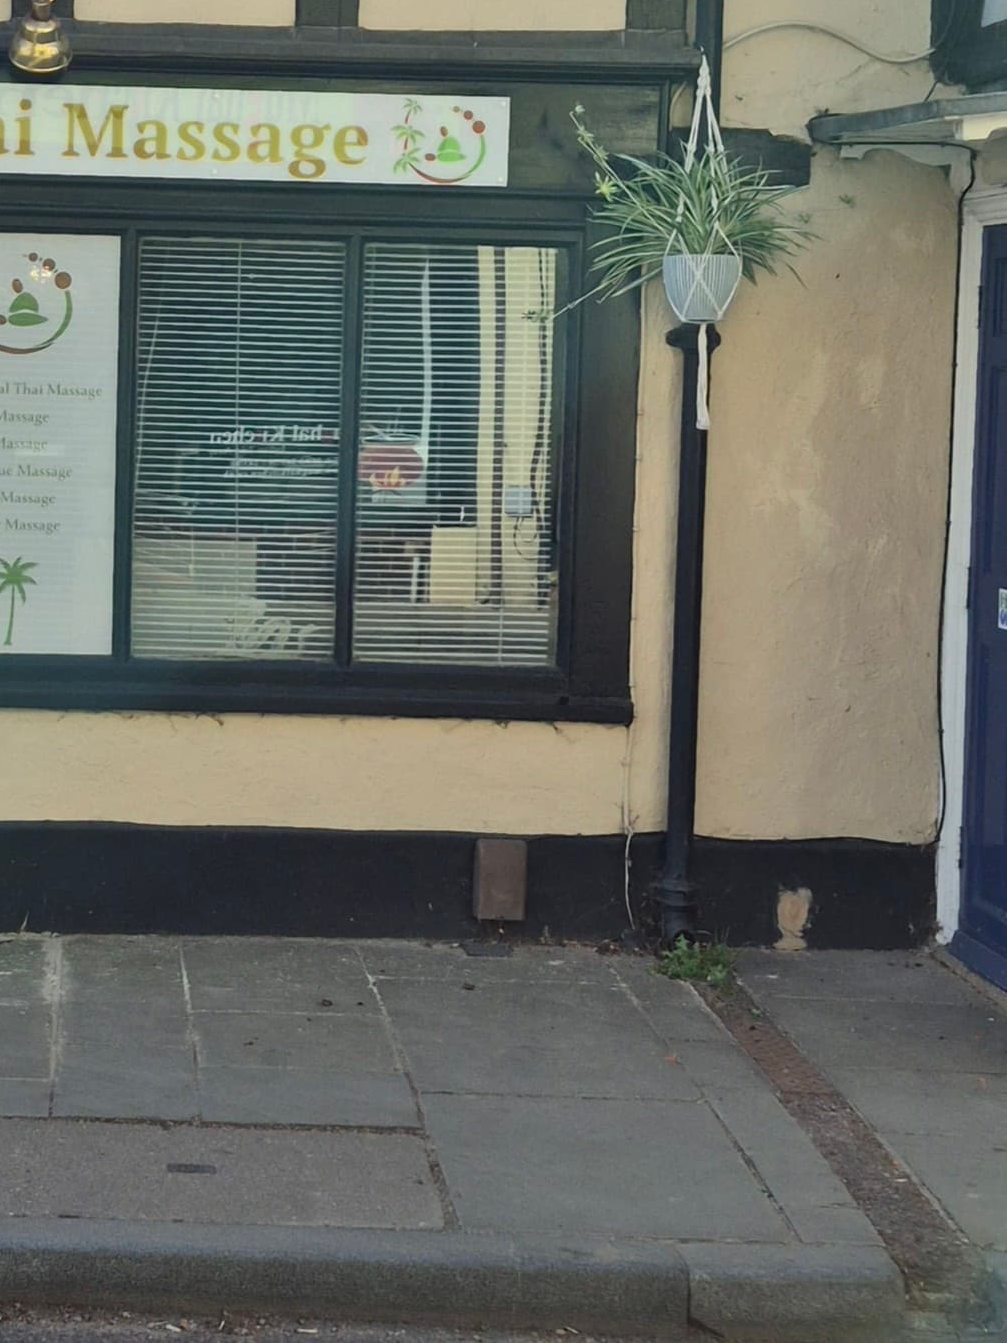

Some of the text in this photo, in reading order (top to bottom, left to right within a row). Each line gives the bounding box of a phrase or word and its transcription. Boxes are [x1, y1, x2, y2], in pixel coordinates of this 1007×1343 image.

[61, 102, 369, 180] Massage
[14, 383, 44, 396] Thai
[46, 383, 103, 401] Massage
[16, 464, 73, 481] Massage
[0, 490, 57, 508] Massage
[4, 518, 62, 535] Massage
